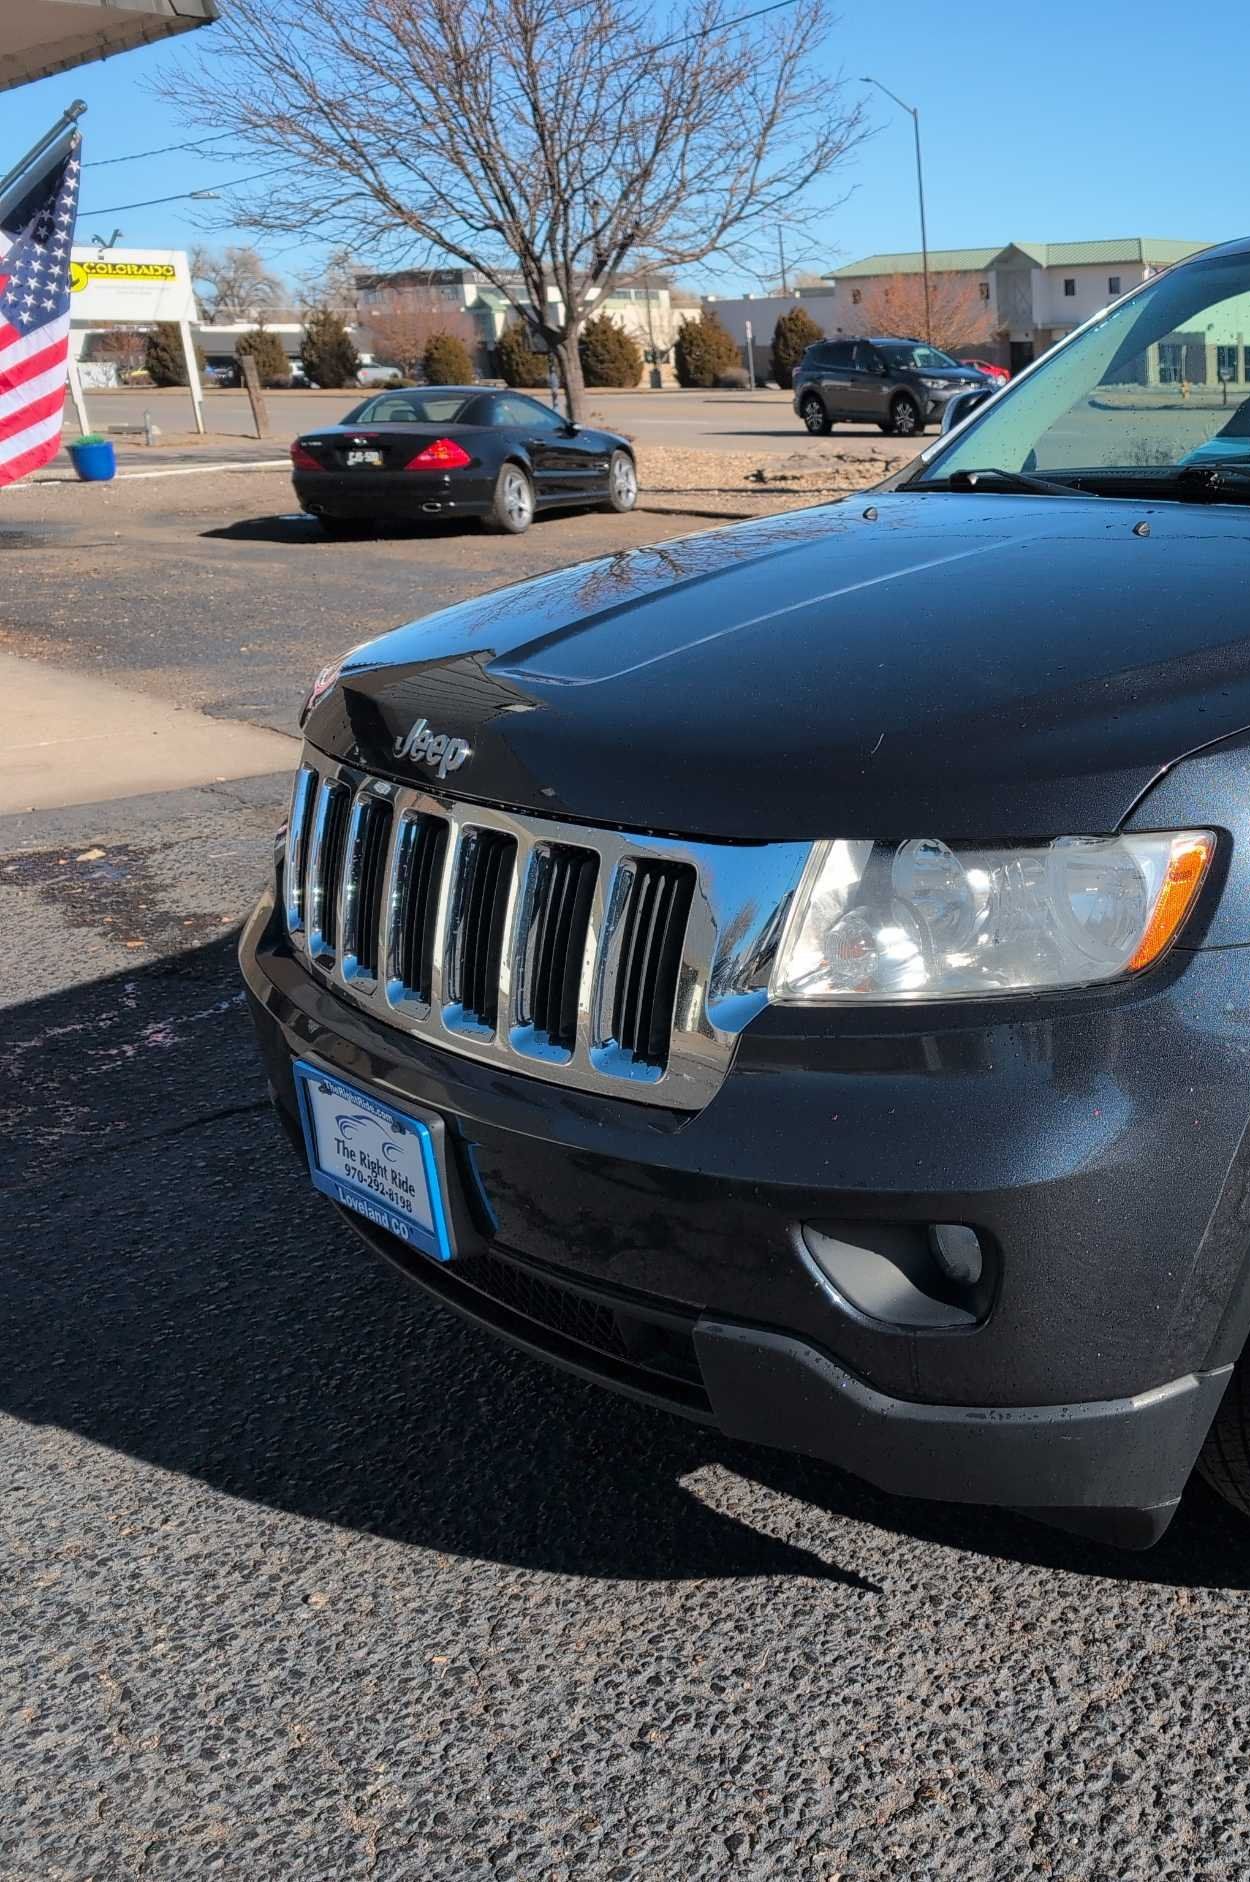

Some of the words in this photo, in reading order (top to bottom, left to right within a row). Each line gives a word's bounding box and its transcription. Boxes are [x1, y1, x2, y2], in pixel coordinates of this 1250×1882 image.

[83, 262, 174, 275] COLORADO
[392, 718, 474, 780] Jeep
[322, 1079, 394, 1125] TheRightRide.com
[334, 1137, 356, 1162] The
[359, 1150, 389, 1182] Right
[391, 1169, 416, 1198] Ride
[344, 1163, 413, 1214] 970-292-8198
[338, 1185, 390, 1230] Loveland
[391, 1218, 409, 1240] CO
